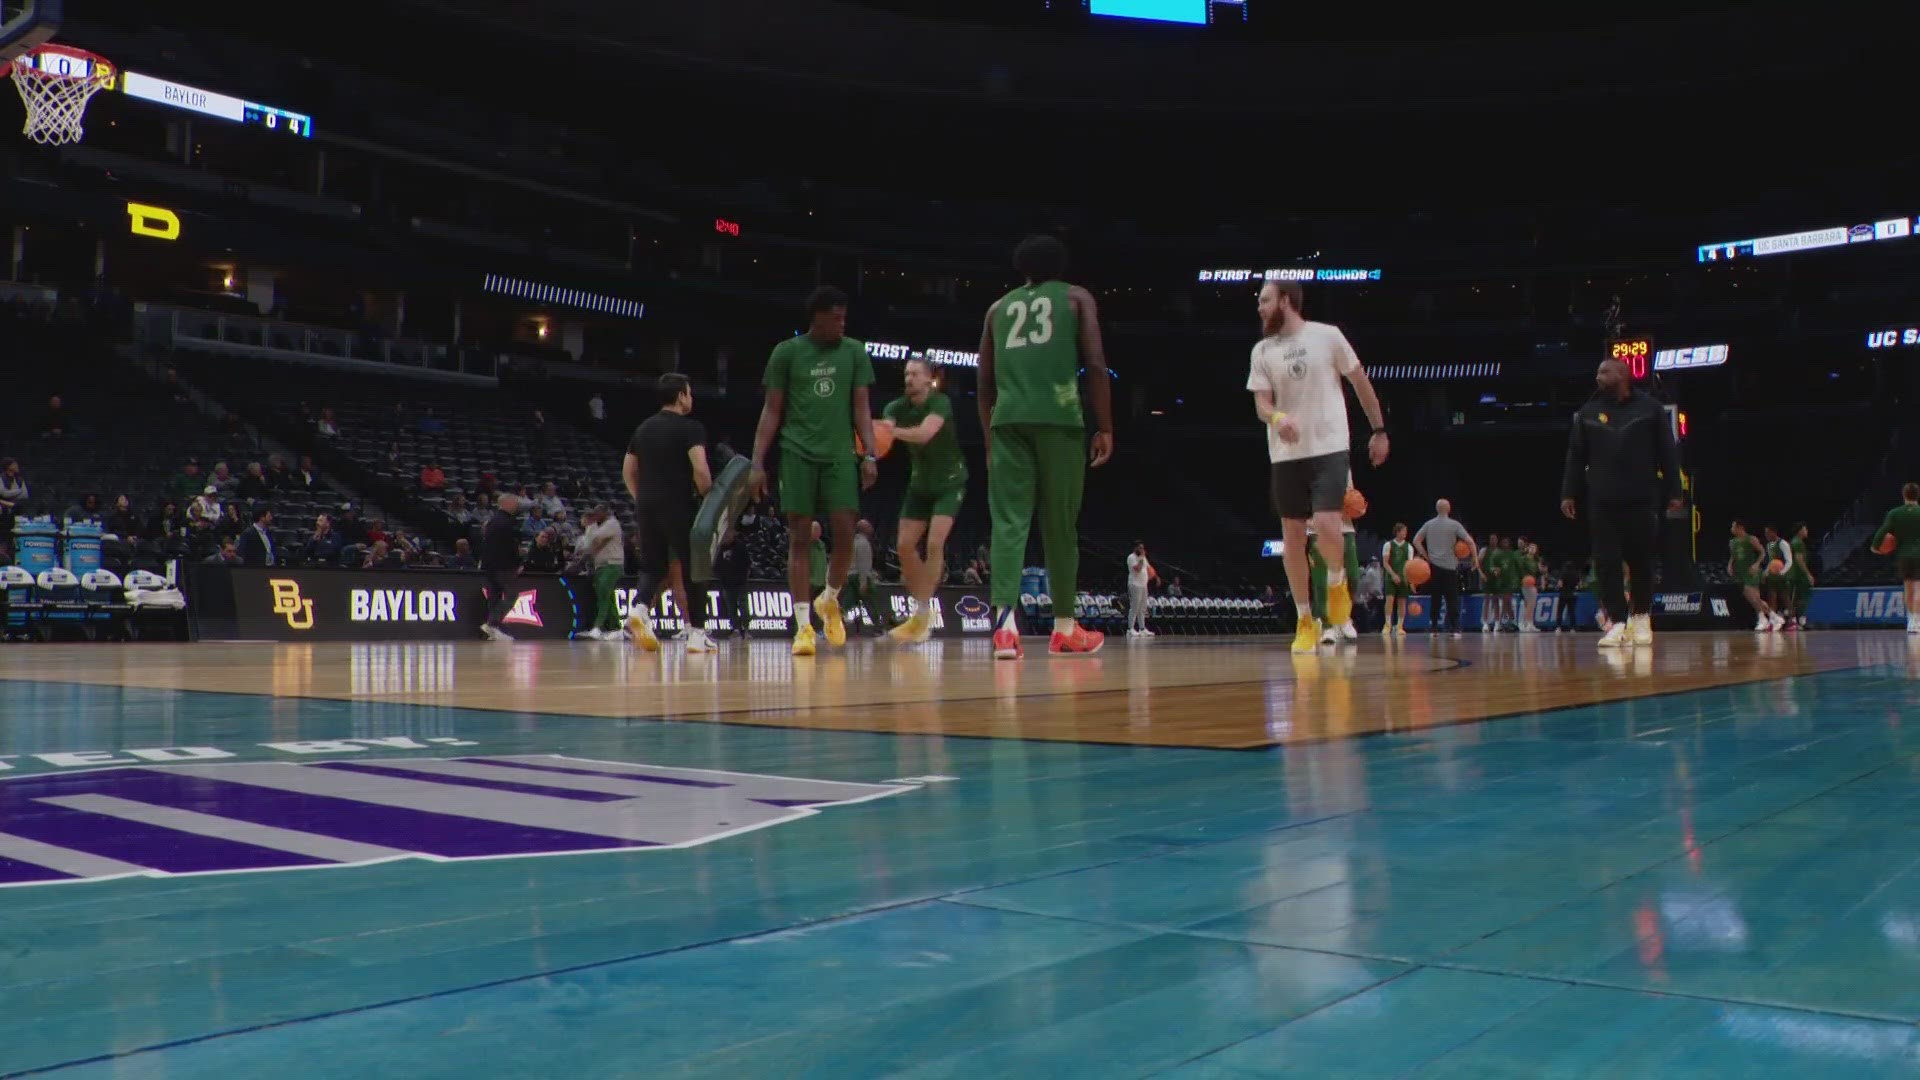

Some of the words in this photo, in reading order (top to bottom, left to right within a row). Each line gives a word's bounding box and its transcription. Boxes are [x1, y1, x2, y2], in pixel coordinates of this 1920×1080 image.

[163, 85, 208, 109] BAYLOR
[266, 113, 276, 128] 0
[1758, 241, 1770, 252] UC
[1771, 236, 1799, 250] SANTA
[1801, 230, 1842, 247] BARBARA
[1214, 269, 1252, 281] FIRST
[1265, 269, 1315, 281] SECOND
[1316, 269, 1368, 281] ROUNDS
[1005, 297, 1053, 350] 23
[1867, 331, 1898, 348] UC
[865, 341, 910, 360] FIRST
[1613, 341, 1648, 358] 29:29
[1654, 344, 1729, 370] UCSB
[269, 578, 314, 630] BU
[351, 589, 456, 622] BAYLOR
[1661, 593, 1688, 604] MARCH
[1664, 602, 1701, 612] MADNESS
[962, 617, 991, 632] UCSB
